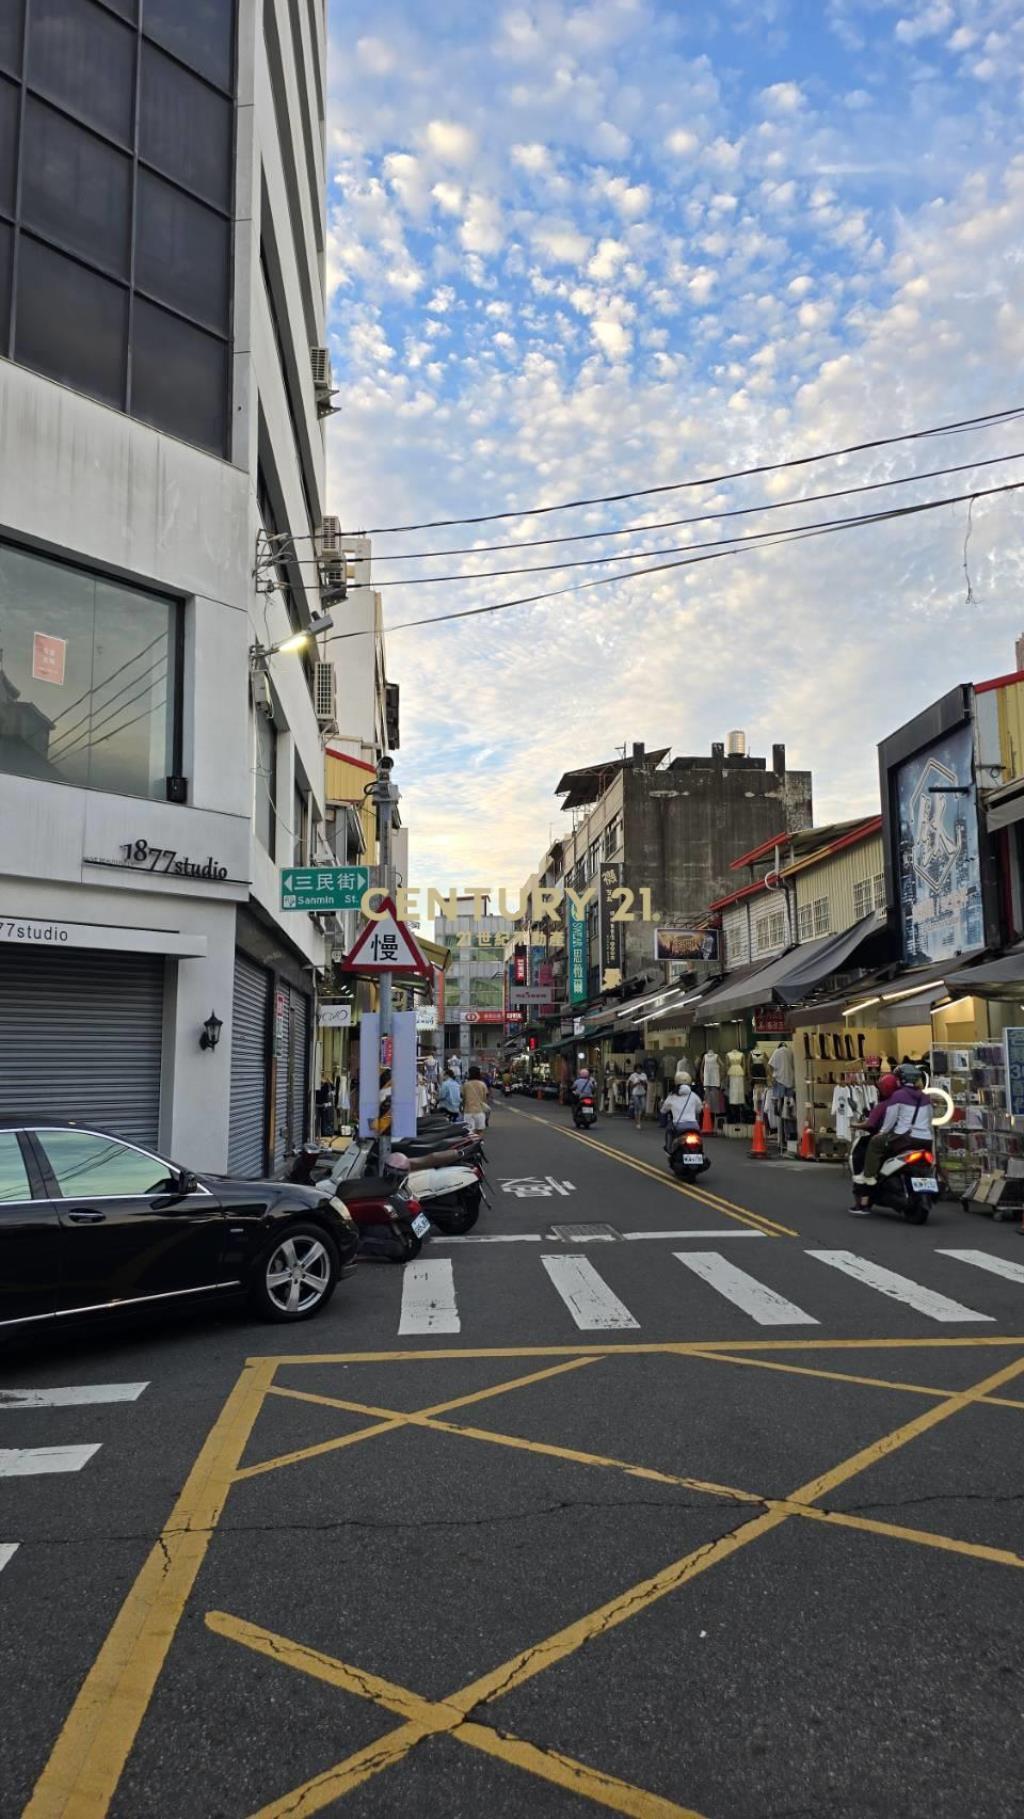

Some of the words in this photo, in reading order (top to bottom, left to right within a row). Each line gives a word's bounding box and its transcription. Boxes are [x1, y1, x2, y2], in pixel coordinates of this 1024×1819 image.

[120, 838, 228, 880] 1877studio
[293, 873, 356, 891] 三民街
[297, 895, 335, 905] Sanmin
[344, 894, 359, 904] St.
[370, 934, 399, 961] 慢
